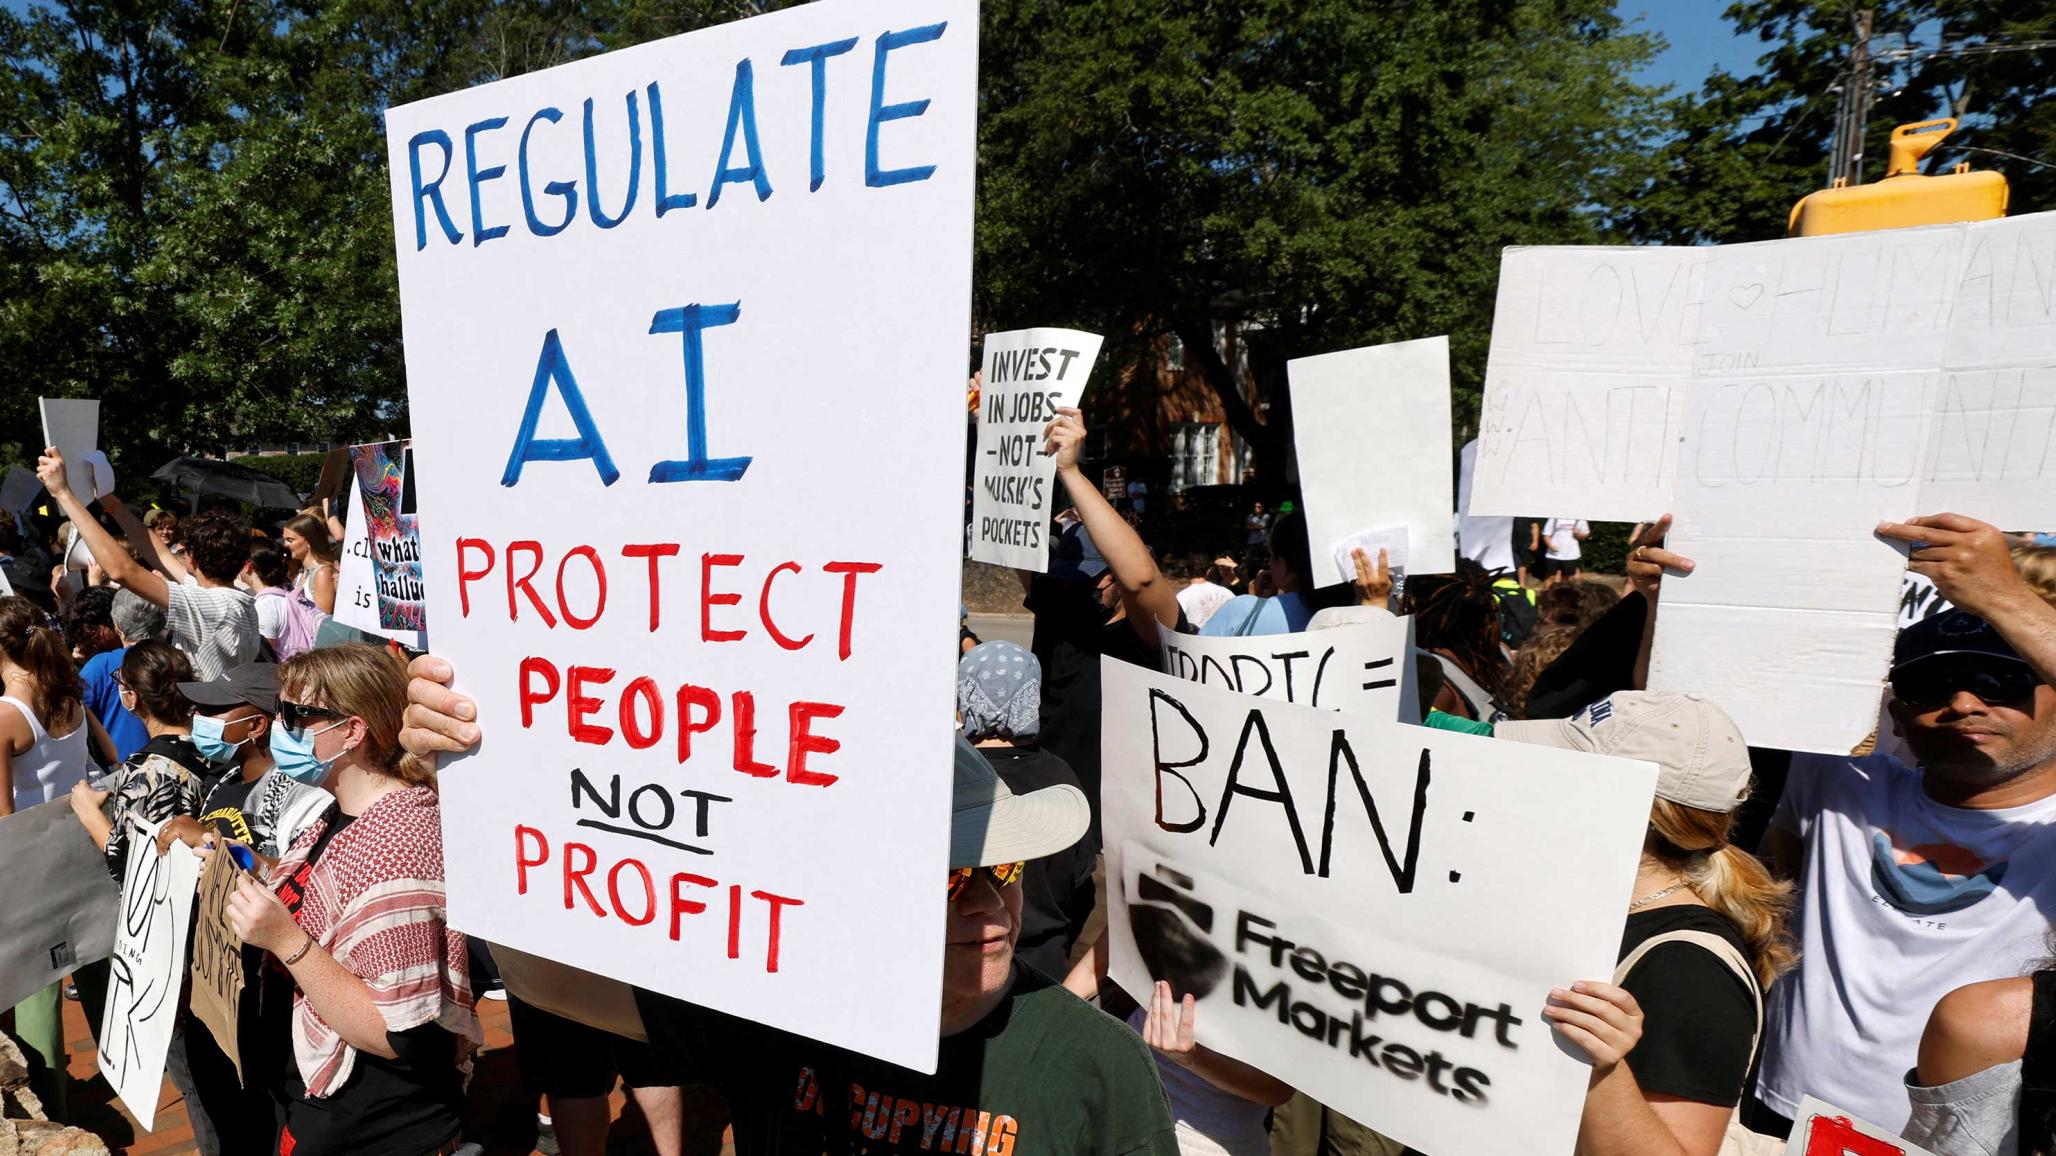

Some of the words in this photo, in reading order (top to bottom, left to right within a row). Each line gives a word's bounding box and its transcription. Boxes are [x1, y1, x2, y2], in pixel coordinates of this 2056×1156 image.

[408, 21, 949, 252] REGULATE
[500, 299, 754, 488] AI
[987, 394, 1005, 424] IN
[1009, 391, 1063, 424] JOBS
[990, 347, 1080, 384] INVEST
[981, 516, 1041, 549] POCKETS
[984, 474, 1044, 511] MUSK'S
[377, 535, 420, 564] what
[354, 585, 372, 609] is
[456, 536, 883, 662] PROTECT
[519, 655, 846, 788] PEOPLE
[570, 768, 734, 838] NOT
[514, 823, 805, 974] PROFIT
[1235, 909, 1525, 1051] Freeport
[1231, 962, 1493, 1108] Markets
[794, 1065, 1019, 1156] OCUPYING
